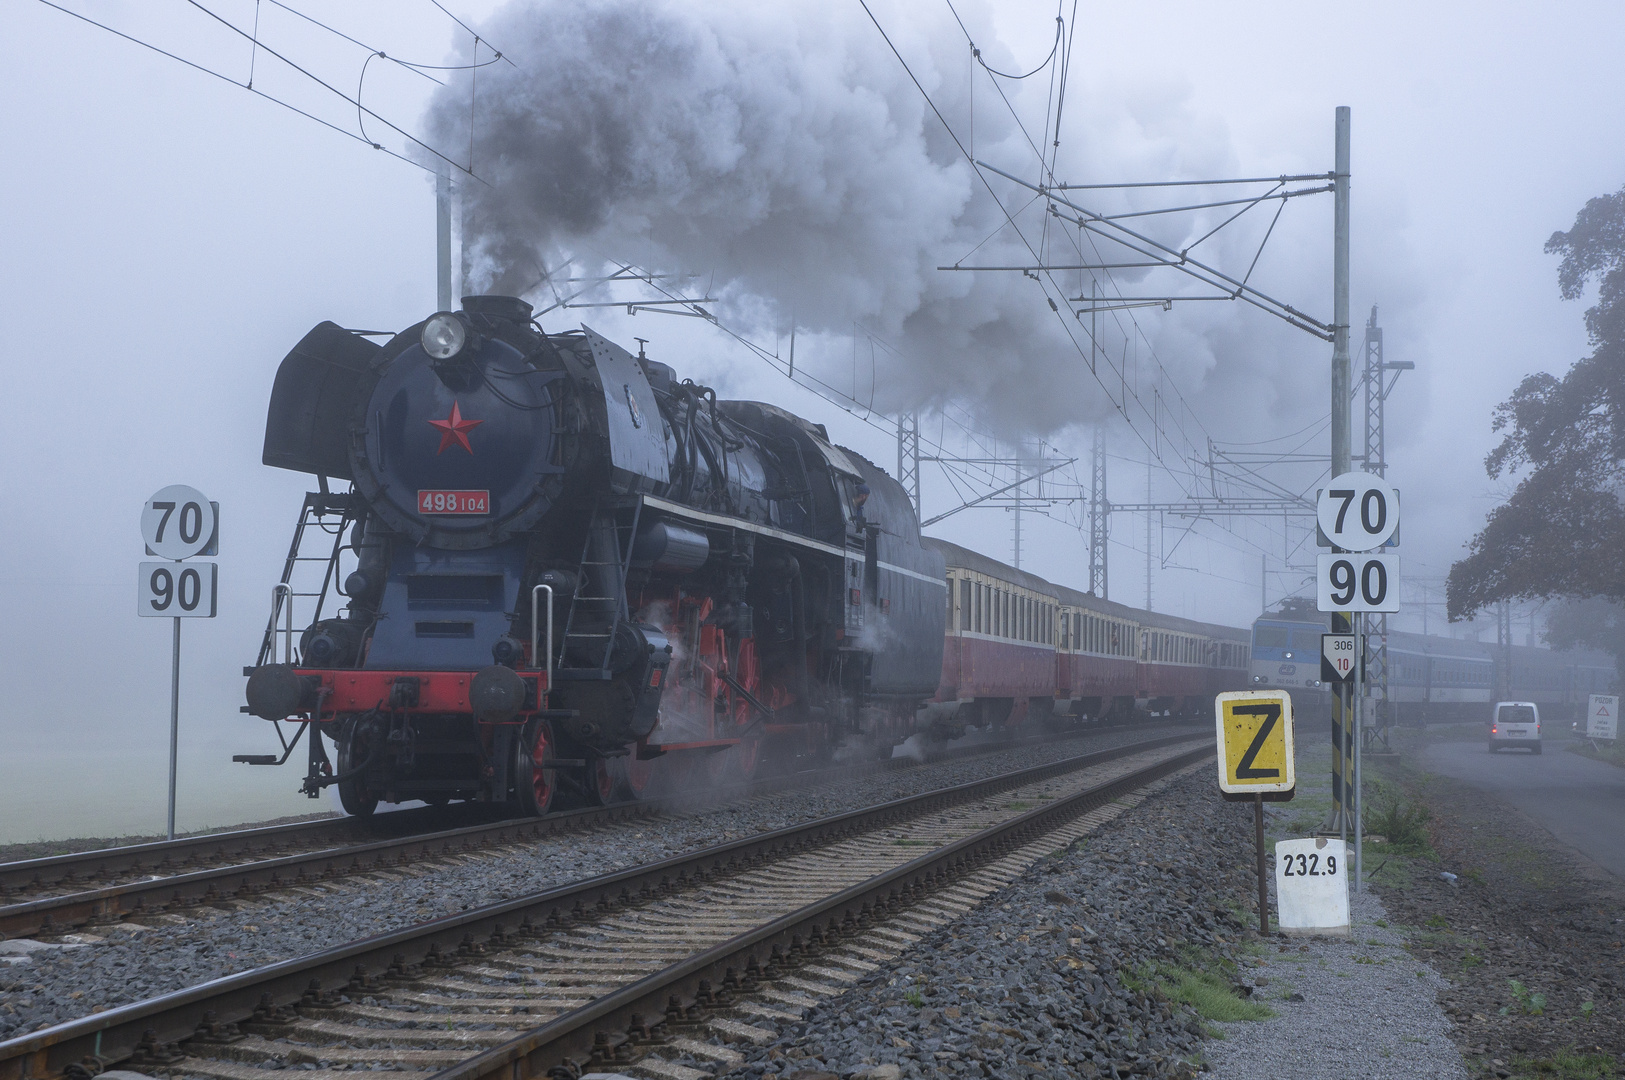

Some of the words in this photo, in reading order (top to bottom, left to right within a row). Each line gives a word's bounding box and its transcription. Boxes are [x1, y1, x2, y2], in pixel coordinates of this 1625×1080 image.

[152, 501, 202, 544] 70
[422, 493, 457, 511] 498
[461, 498, 484, 511] 104
[1329, 489, 1387, 534] 70
[150, 568, 201, 611] 90
[1329, 559, 1387, 605] 90
[1334, 640, 1353, 650] 306
[1337, 658, 1349, 670] 10
[1232, 703, 1281, 779] Z
[1283, 853, 1337, 876] 232.9
